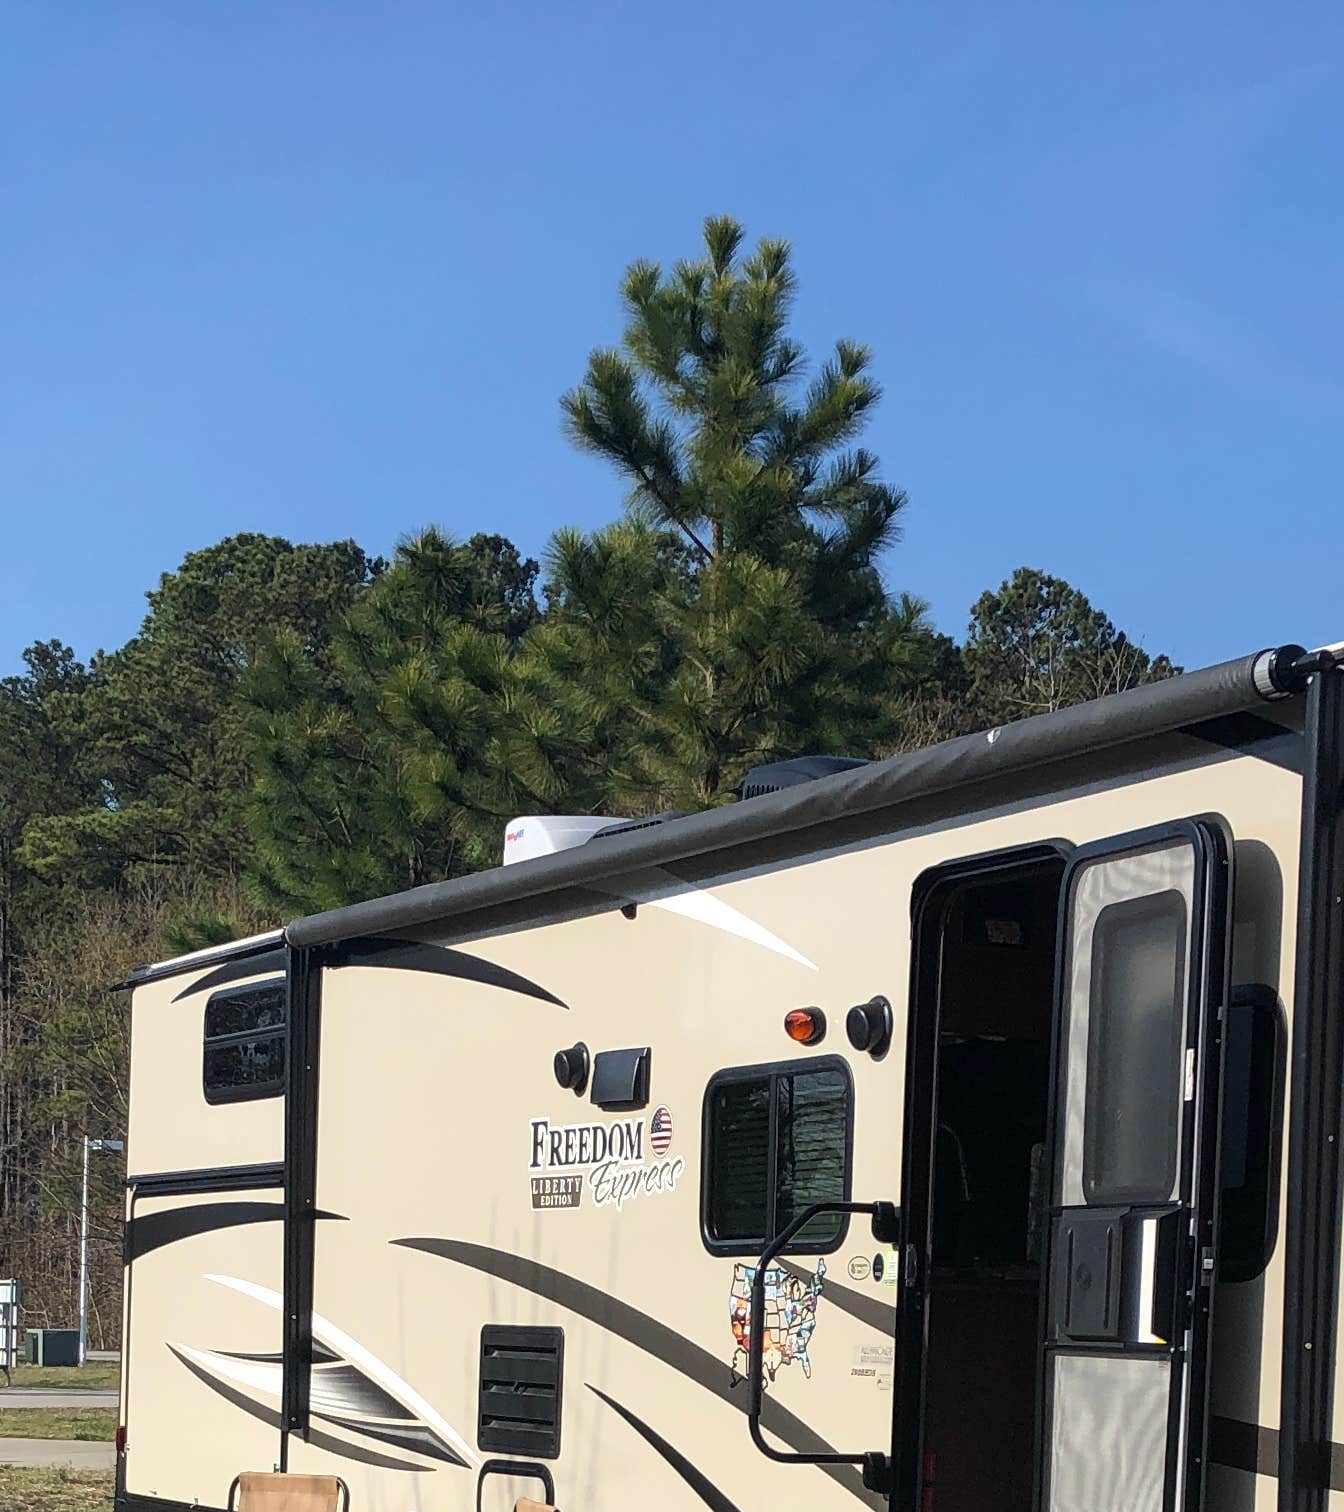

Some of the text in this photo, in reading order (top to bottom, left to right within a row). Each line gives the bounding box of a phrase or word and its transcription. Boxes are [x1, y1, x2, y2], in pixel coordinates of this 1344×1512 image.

[529, 1120, 644, 1168] FREEDOM
[532, 1178, 581, 1195] LIBERTY
[589, 1159, 683, 1207] Express
[540, 1194, 573, 1206] EDITION
